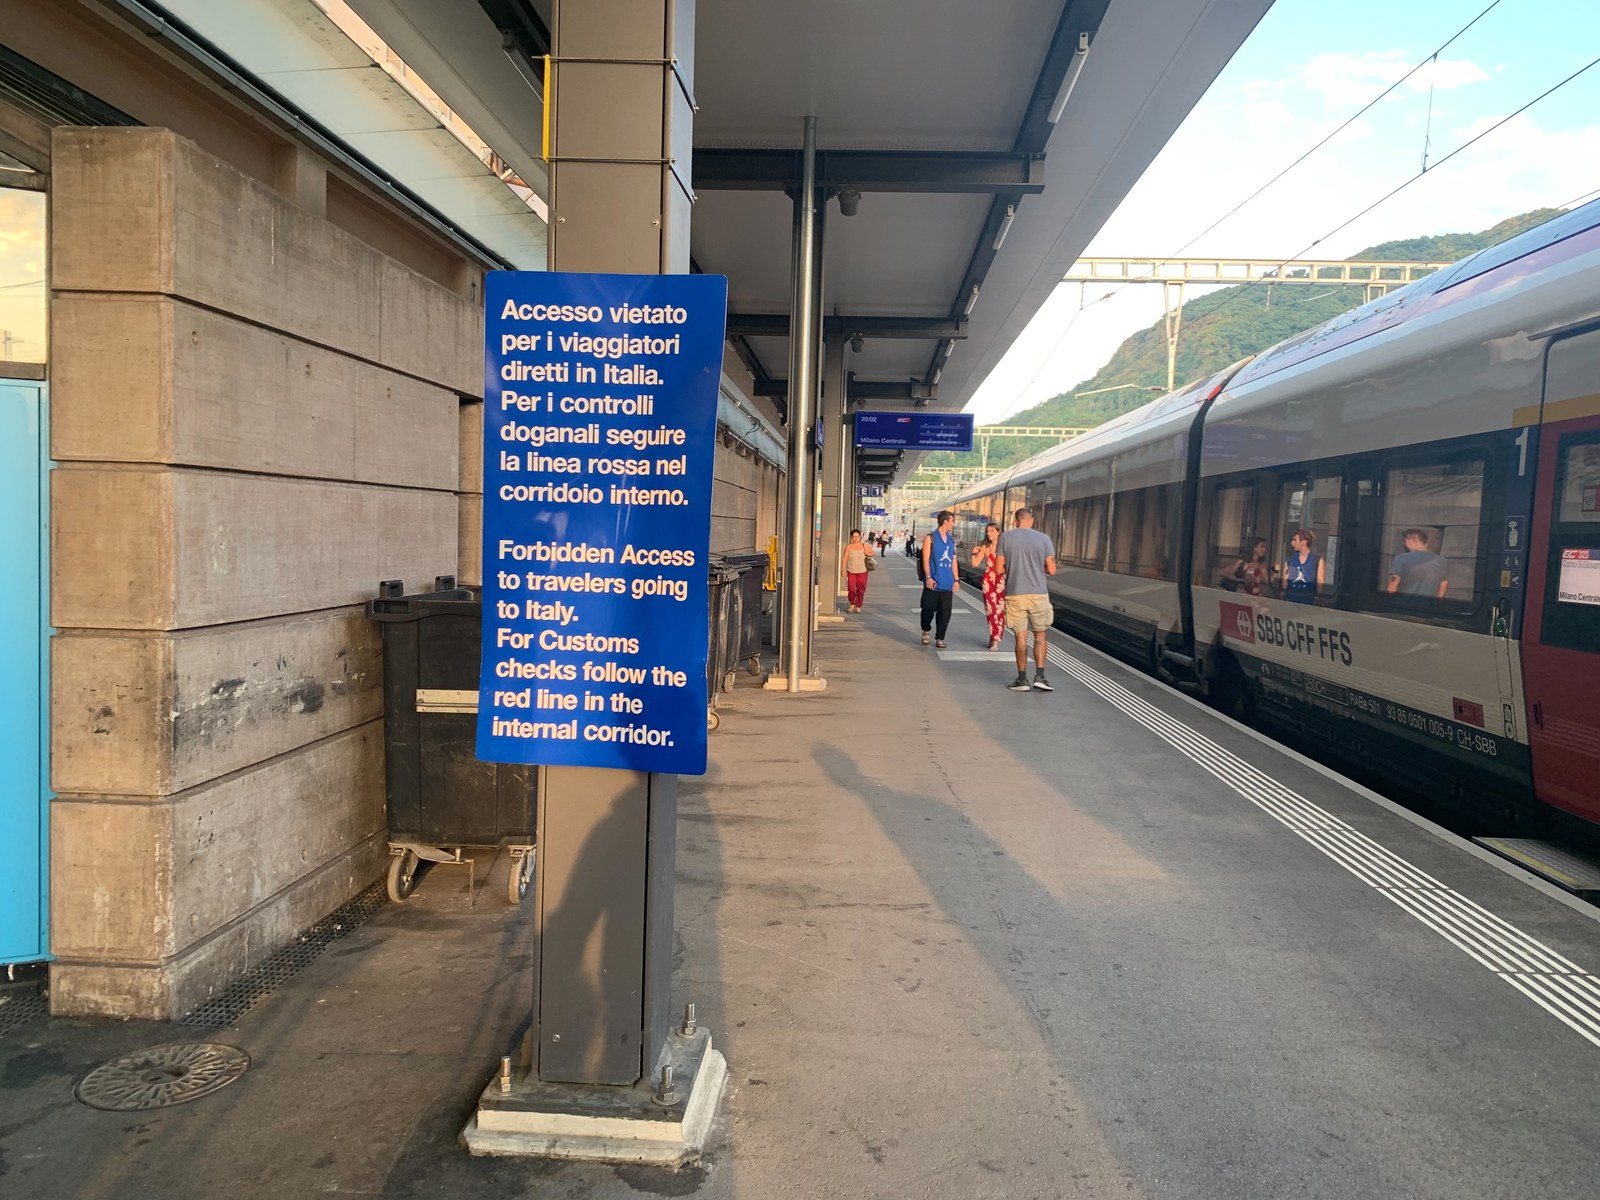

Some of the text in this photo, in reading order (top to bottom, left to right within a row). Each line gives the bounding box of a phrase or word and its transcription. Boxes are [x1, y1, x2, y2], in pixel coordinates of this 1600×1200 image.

[500, 299, 688, 325] Accesso vietato
[501, 331, 680, 359] per i viaggiatori
[500, 360, 664, 386] diretti in Italia.
[501, 390, 654, 416] Per i controlli
[500, 420, 686, 451] doganali seguire
[500, 450, 687, 476] la linea rossa nel
[1515, 426, 1529, 477] 1
[499, 481, 689, 506] corridoio interno.
[498, 539, 695, 567] Forbidden Access
[497, 570, 688, 602] to travelers going
[1559, 591, 1577, 600] Milano
[496, 599, 579, 626] to Italy.
[497, 627, 640, 655] For Customs
[1256, 613, 1353, 667] SBB CFF FFS
[495, 657, 687, 688] checks follow the
[493, 688, 643, 715] red line in the
[492, 715, 674, 747] internal corridor.
[1349, 692, 1497, 756] RABe 501 93 85 0501 005-9 CH-SBB
